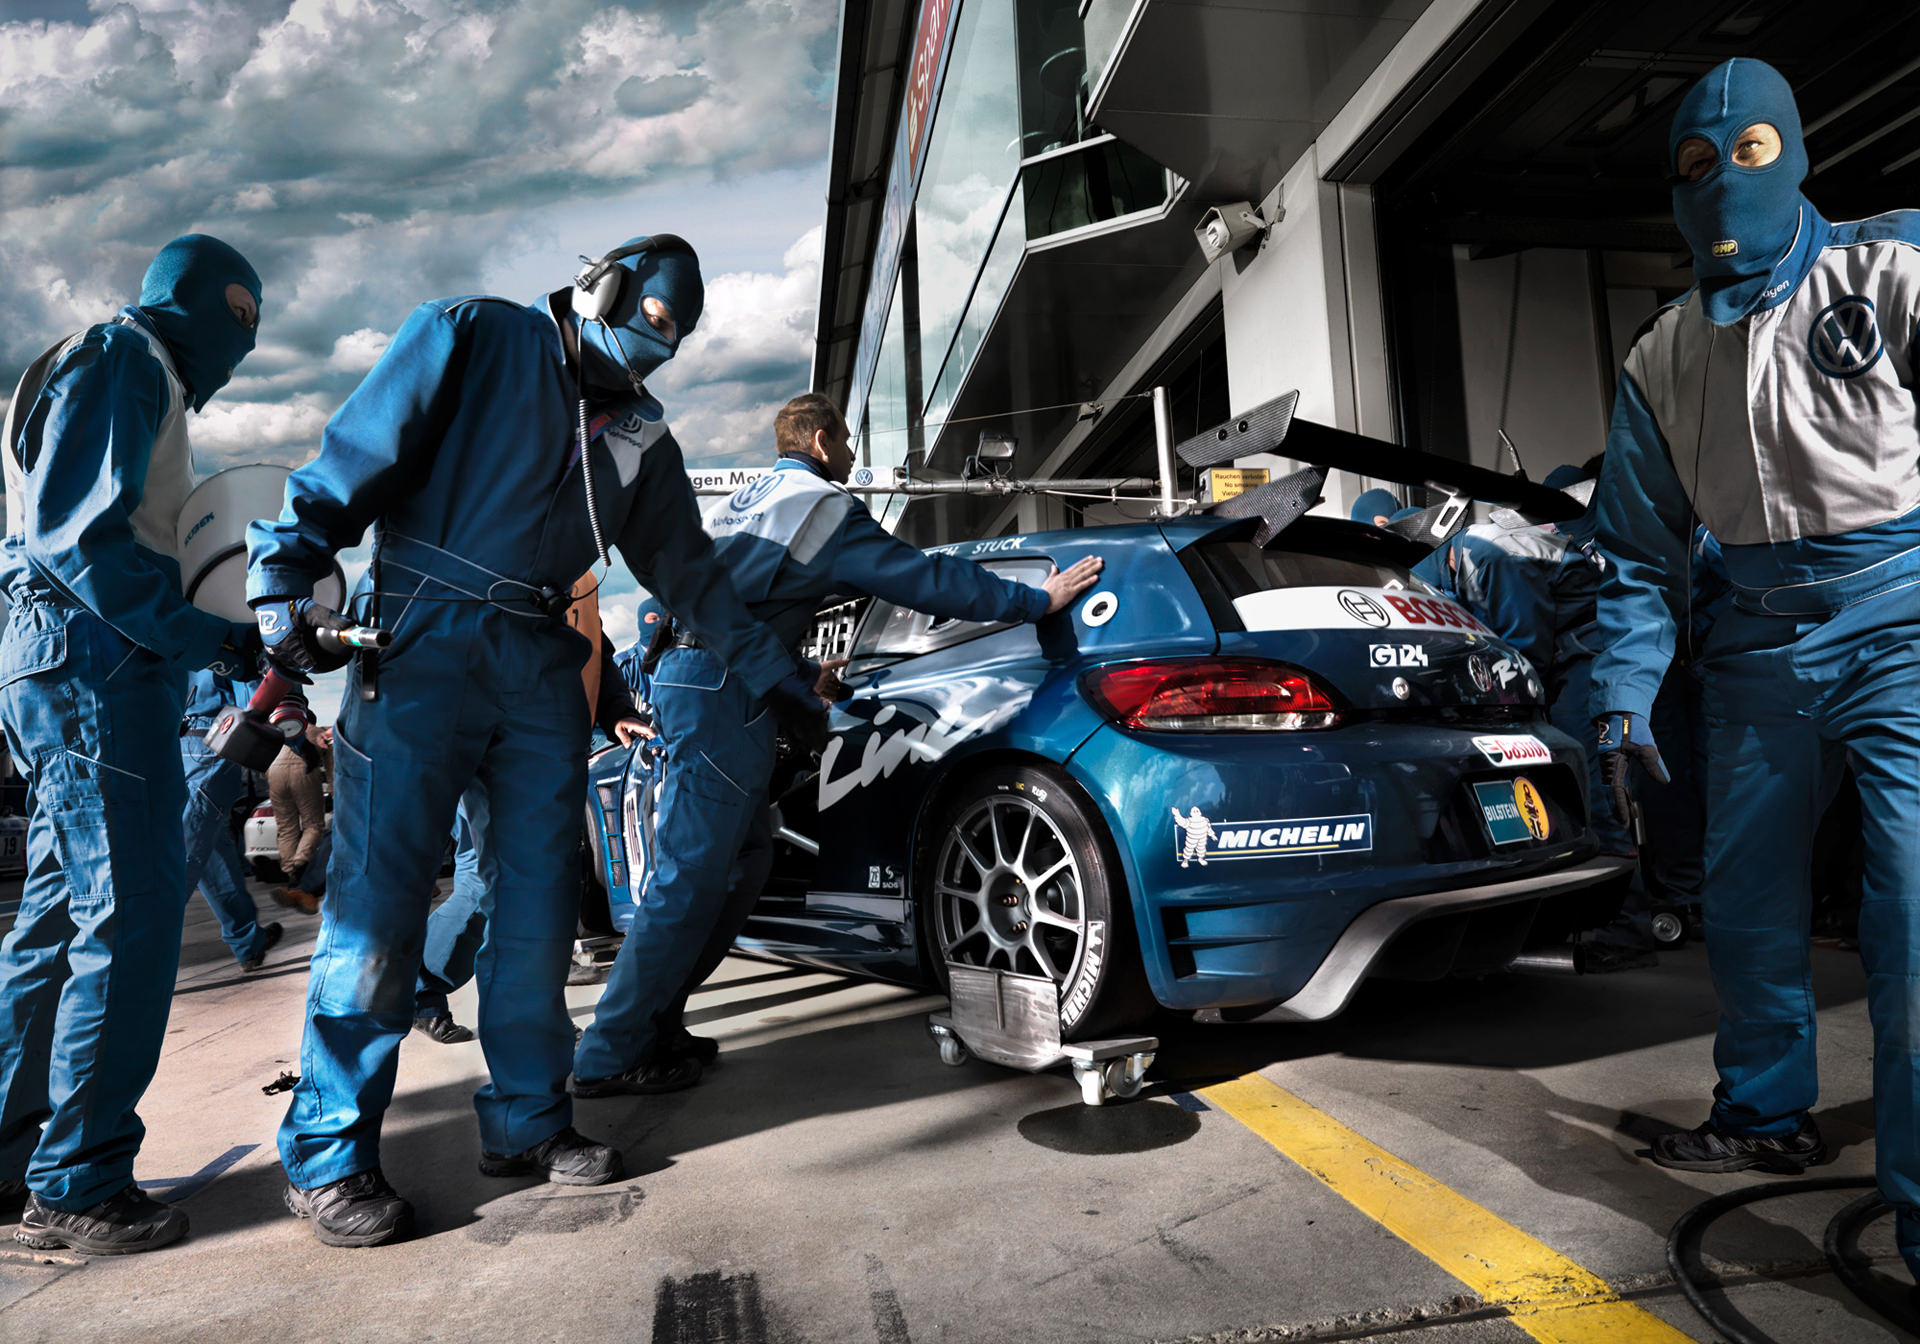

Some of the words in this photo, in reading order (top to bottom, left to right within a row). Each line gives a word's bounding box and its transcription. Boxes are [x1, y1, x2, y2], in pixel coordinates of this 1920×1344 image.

[691, 475, 723, 489] gen
[971, 536, 1028, 555] STUCK
[1494, 740, 1549, 760] Castrol
[1483, 802, 1520, 822] BILSTEIN
[1217, 822, 1366, 849] MICHELIN
[1060, 949, 1102, 1031] MICHEL
